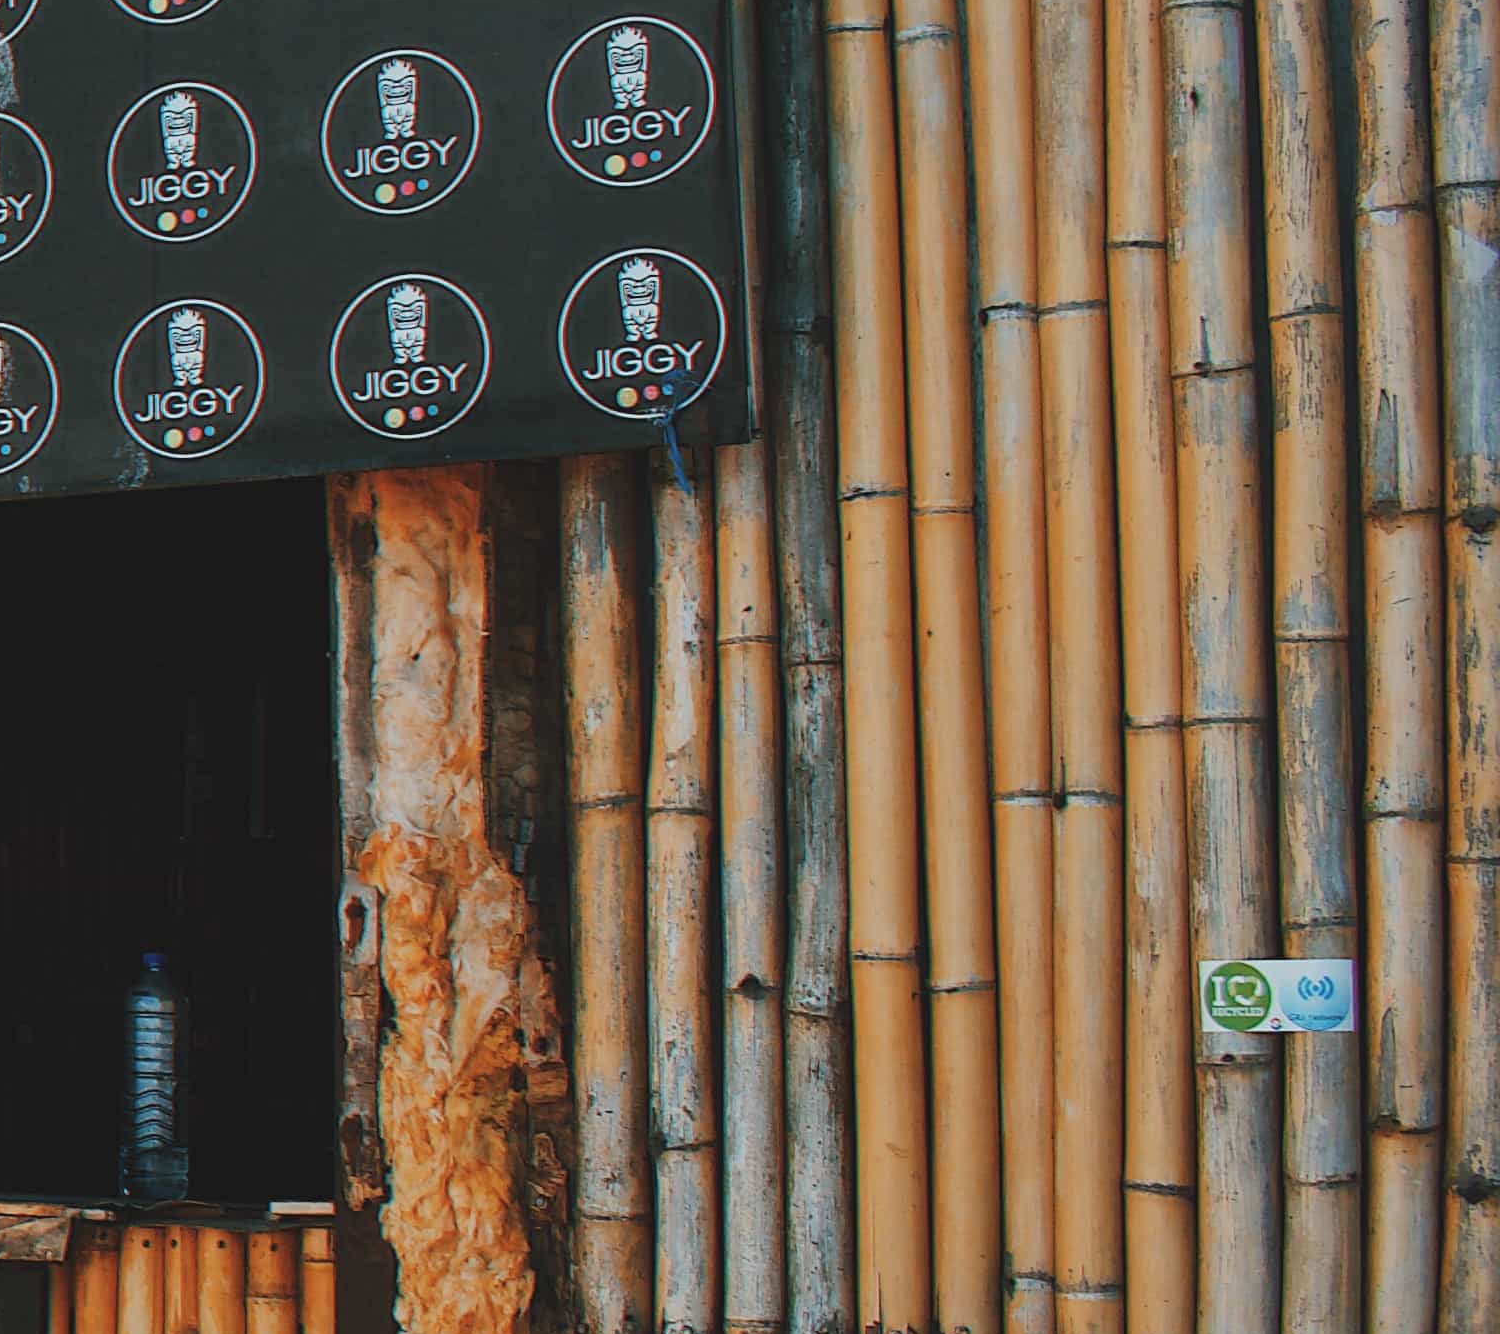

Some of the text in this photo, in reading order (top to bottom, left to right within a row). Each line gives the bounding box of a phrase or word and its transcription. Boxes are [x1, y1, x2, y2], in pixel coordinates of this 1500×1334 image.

[571, 106, 691, 148] JIGGY
[344, 136, 457, 177] JIGGY
[128, 166, 235, 206] JIGGY
[583, 341, 702, 379] JIGGY
[353, 363, 467, 401] JIGGY
[135, 385, 243, 422] JIGGY
